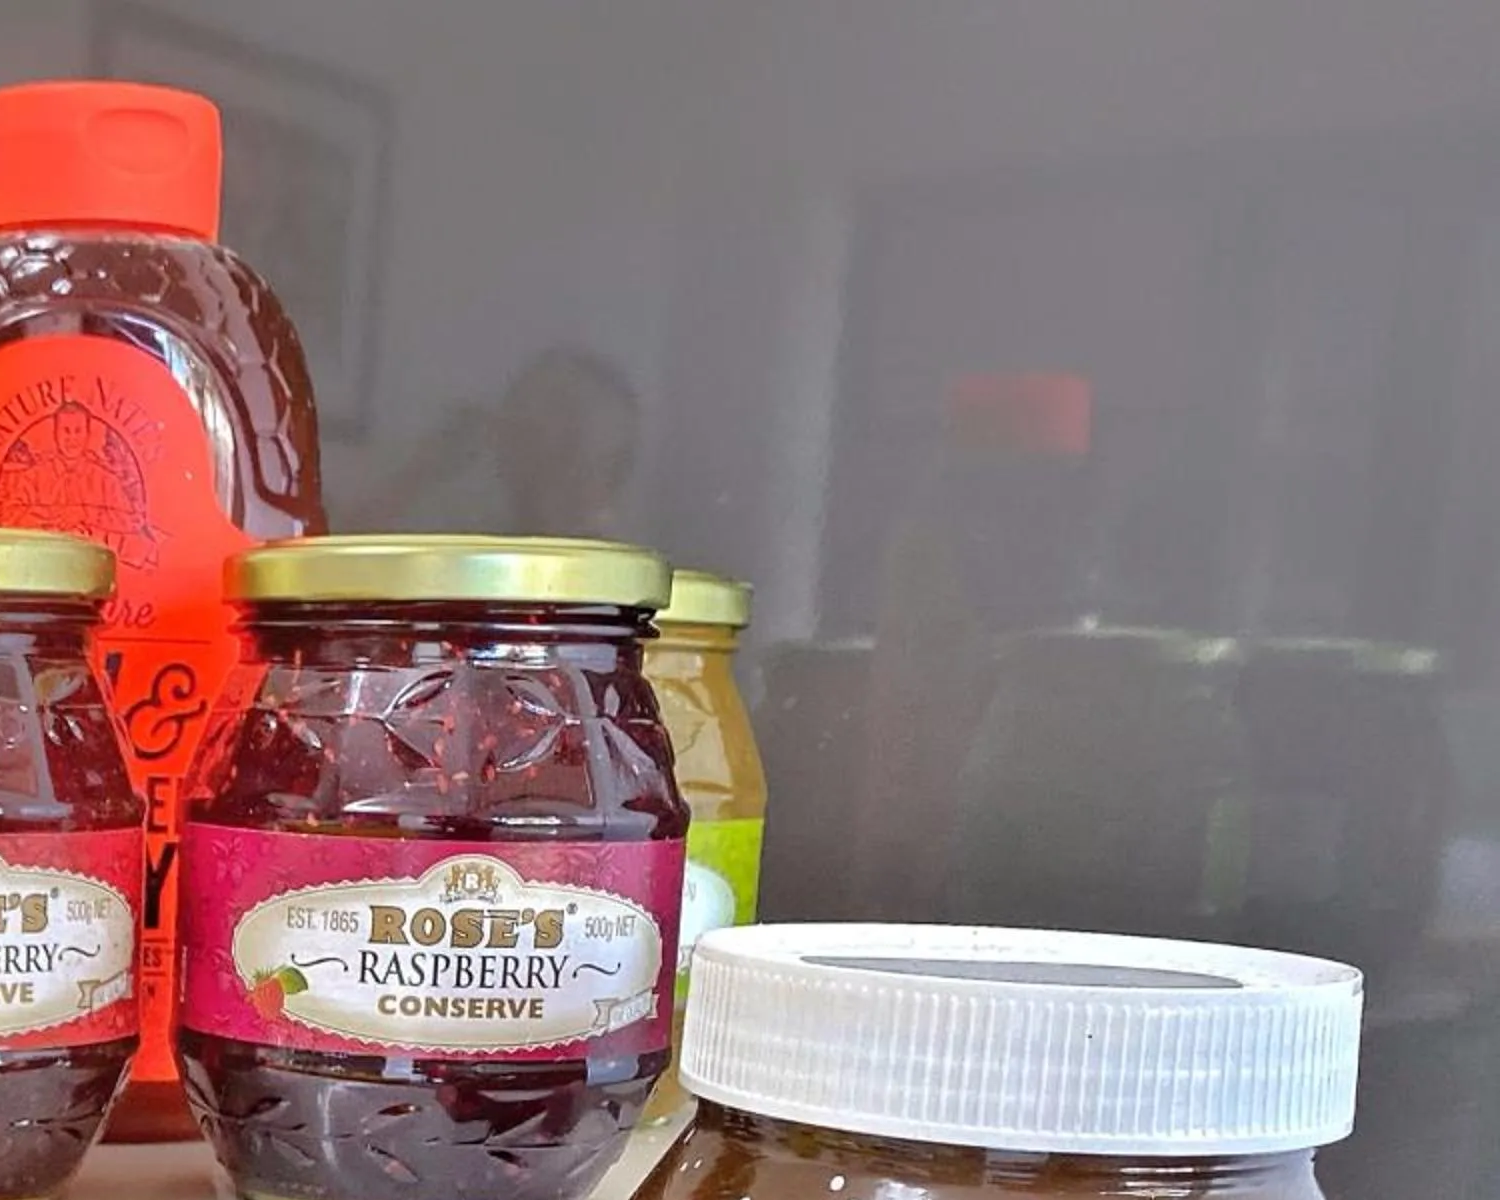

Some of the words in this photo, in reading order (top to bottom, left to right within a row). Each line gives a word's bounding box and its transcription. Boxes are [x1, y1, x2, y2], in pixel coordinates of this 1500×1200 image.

[321, 909, 360, 934] 1865
[368, 905, 566, 950] ROSE'S
[584, 917, 615, 943] 500g
[615, 914, 637, 938] NET
[357, 949, 570, 989] RASPBERRY
[377, 994, 545, 1020] CONSERVE
